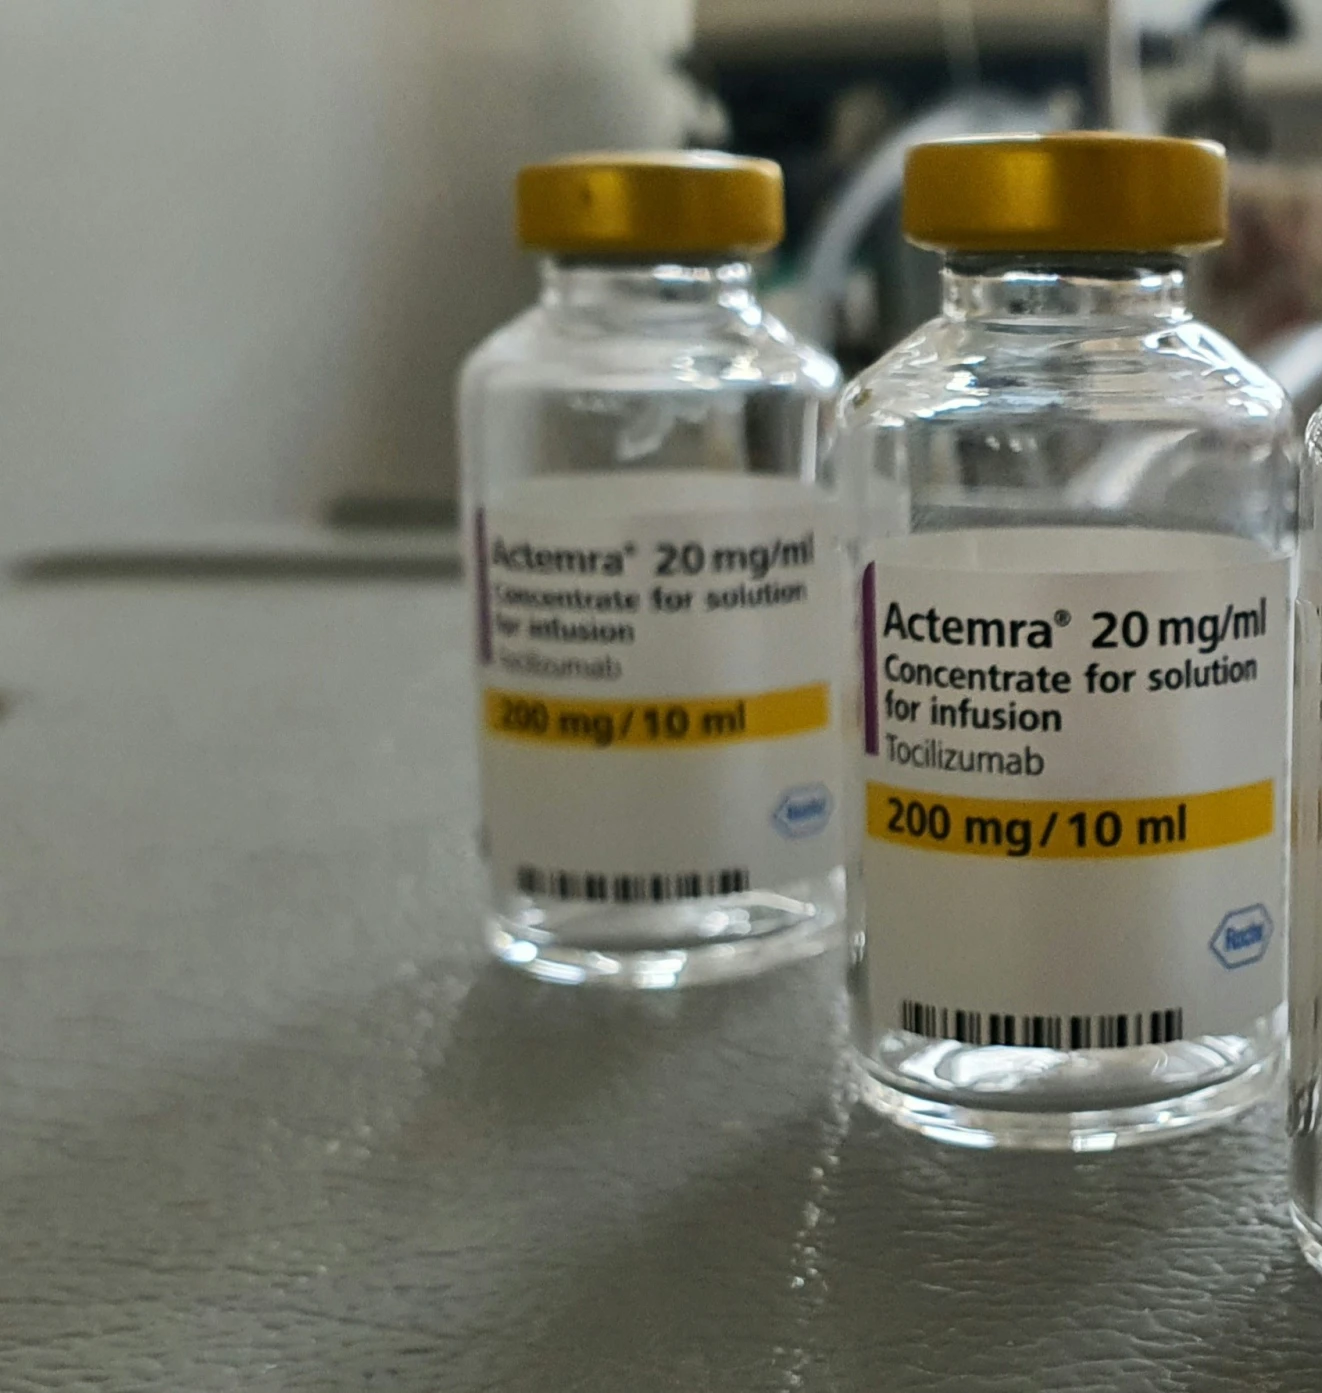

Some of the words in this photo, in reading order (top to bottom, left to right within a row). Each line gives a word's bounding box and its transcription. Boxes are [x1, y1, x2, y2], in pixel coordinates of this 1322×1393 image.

[656, 539, 705, 576] 20
[713, 530, 815, 580] mg/ml
[651, 585, 693, 614] for
[1091, 611, 1149, 650] 20
[1158, 597, 1267, 654] mg/ml
[884, 653, 1071, 694] Concentrate
[1085, 663, 1136, 694] for
[1148, 656, 1257, 692] solution
[702, 702, 746, 735] ml
[885, 690, 918, 723] for
[930, 697, 1063, 732] infusion
[886, 733, 1045, 777] Tocilizumab
[887, 797, 951, 840] 200
[1137, 803, 1187, 844] ml
